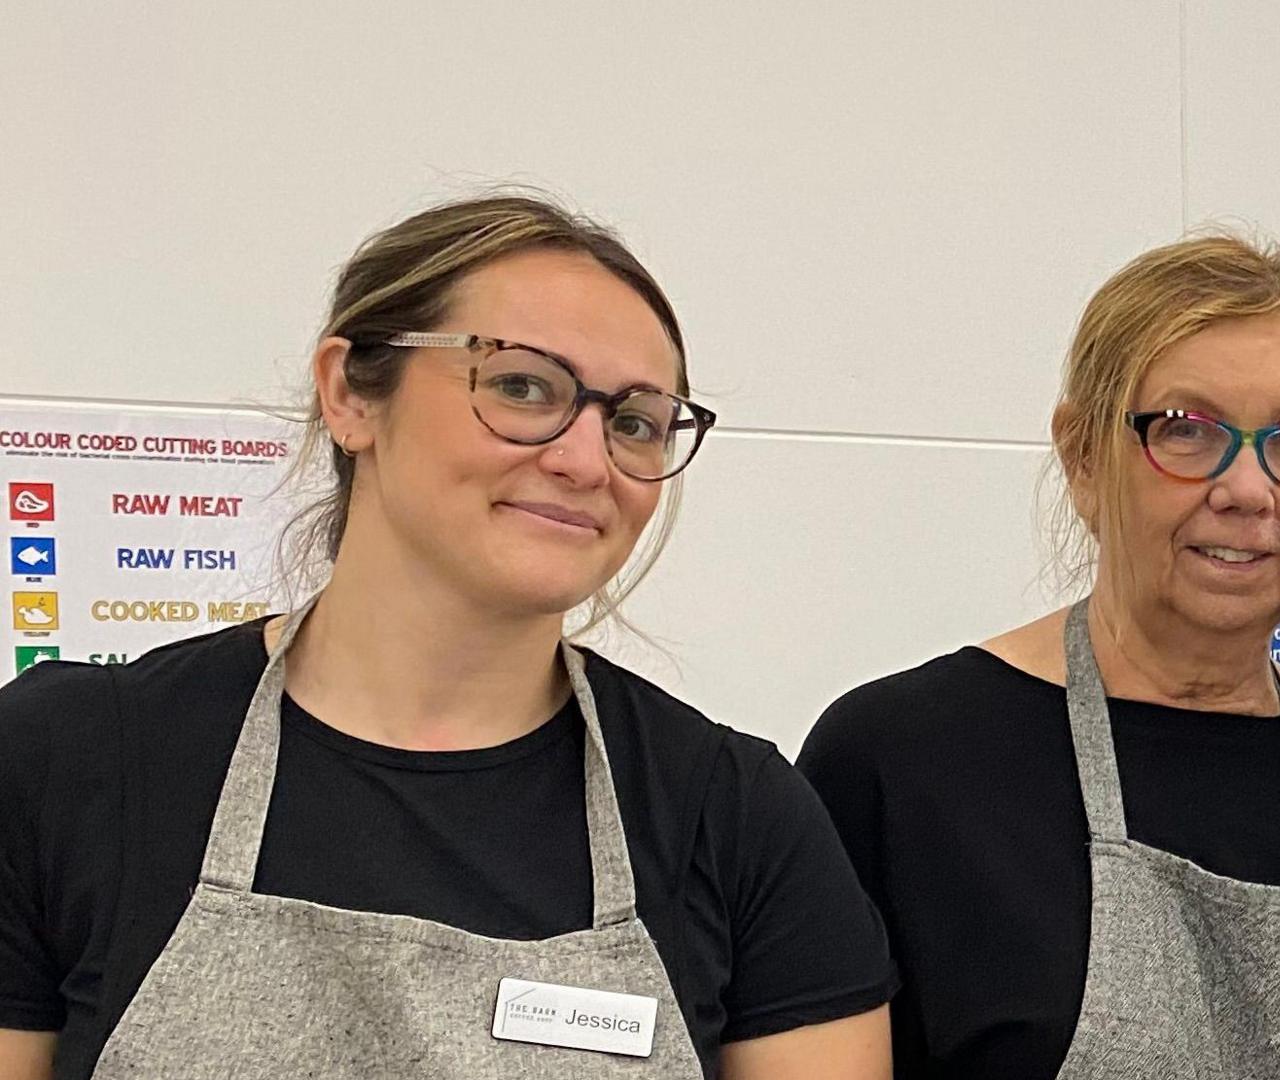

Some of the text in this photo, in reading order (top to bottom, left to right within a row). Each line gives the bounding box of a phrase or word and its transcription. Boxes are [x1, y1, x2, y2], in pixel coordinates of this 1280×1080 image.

[0, 431, 288, 458] COLOUR CODED CUTTING BOARDS
[112, 494, 243, 517] RAW MEAT
[117, 548, 236, 570] RAW FISH
[91, 600, 271, 623] COOKED MEAT
[510, 1003, 557, 1016] THE BARN
[565, 1008, 641, 1034] Jessica
